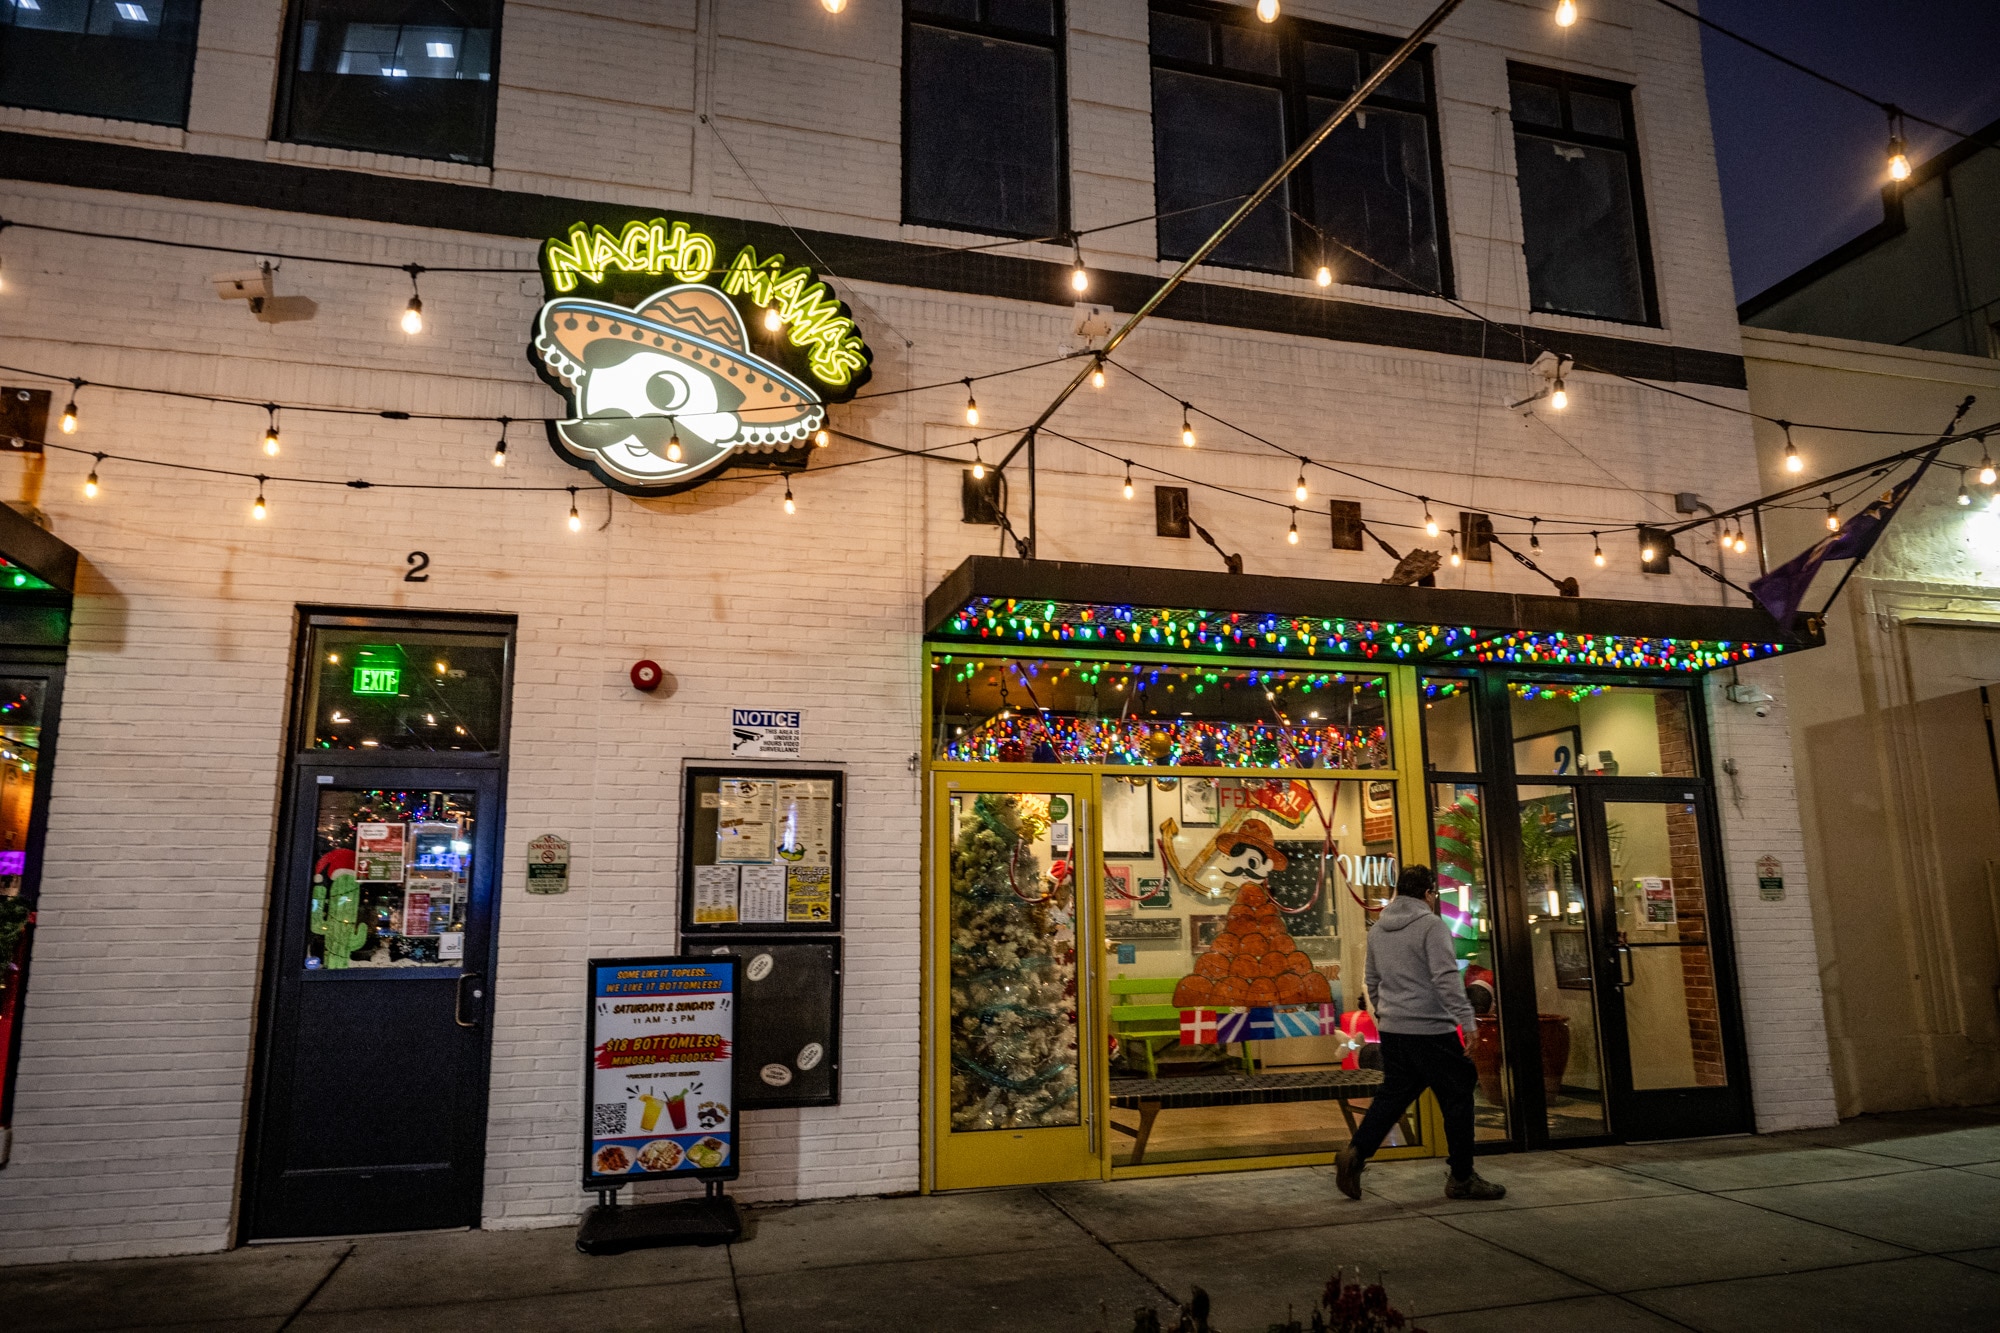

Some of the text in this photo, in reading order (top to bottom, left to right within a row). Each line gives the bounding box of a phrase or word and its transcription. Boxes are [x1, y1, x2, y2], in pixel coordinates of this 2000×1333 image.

[546, 217, 716, 293] NACHO
[403, 551, 430, 583] 2
[360, 670, 396, 691] EXIT
[734, 711, 798, 727] NOTICE
[789, 866, 829, 875] COLLEGE
[617, 968, 712, 980] SOME LIKE IT TOPLESS...
[606, 980, 722, 993] WE LIKE IT BOTTOMLESS!
[613, 1001, 715, 1015] SATURDAYS & SUNDAYS
[645, 1016, 661, 1024] AM
[680, 1014, 696, 1022] PM
[606, 1034, 721, 1053] $18 BOTTOMLESS
[611, 1055, 657, 1066] MIMOSAS
[669, 1052, 715, 1064] BLOODY'S
